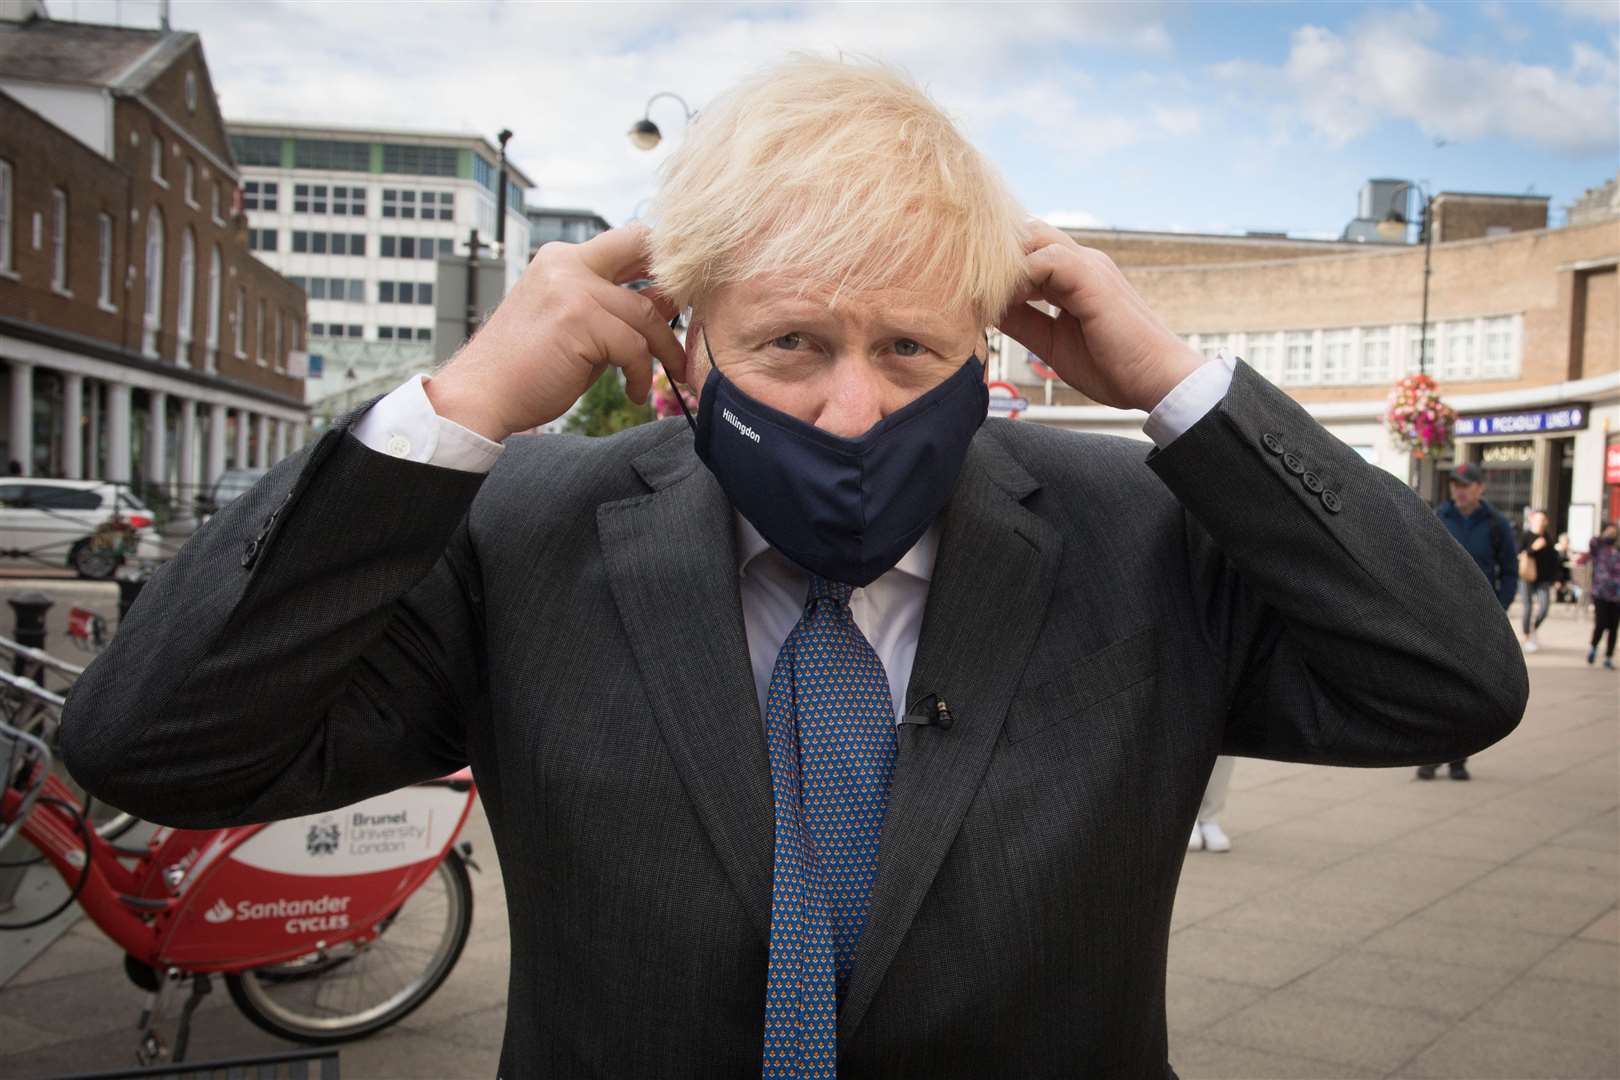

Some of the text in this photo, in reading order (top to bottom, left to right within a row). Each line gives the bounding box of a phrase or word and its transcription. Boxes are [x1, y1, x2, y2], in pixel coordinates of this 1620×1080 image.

[722, 407, 760, 444] Hillingdon
[352, 810, 407, 827] Brunel
[351, 825, 425, 841] University
[349, 840, 405, 856] London
[237, 895, 351, 921] Santander
[286, 914, 349, 934] CYCLES
